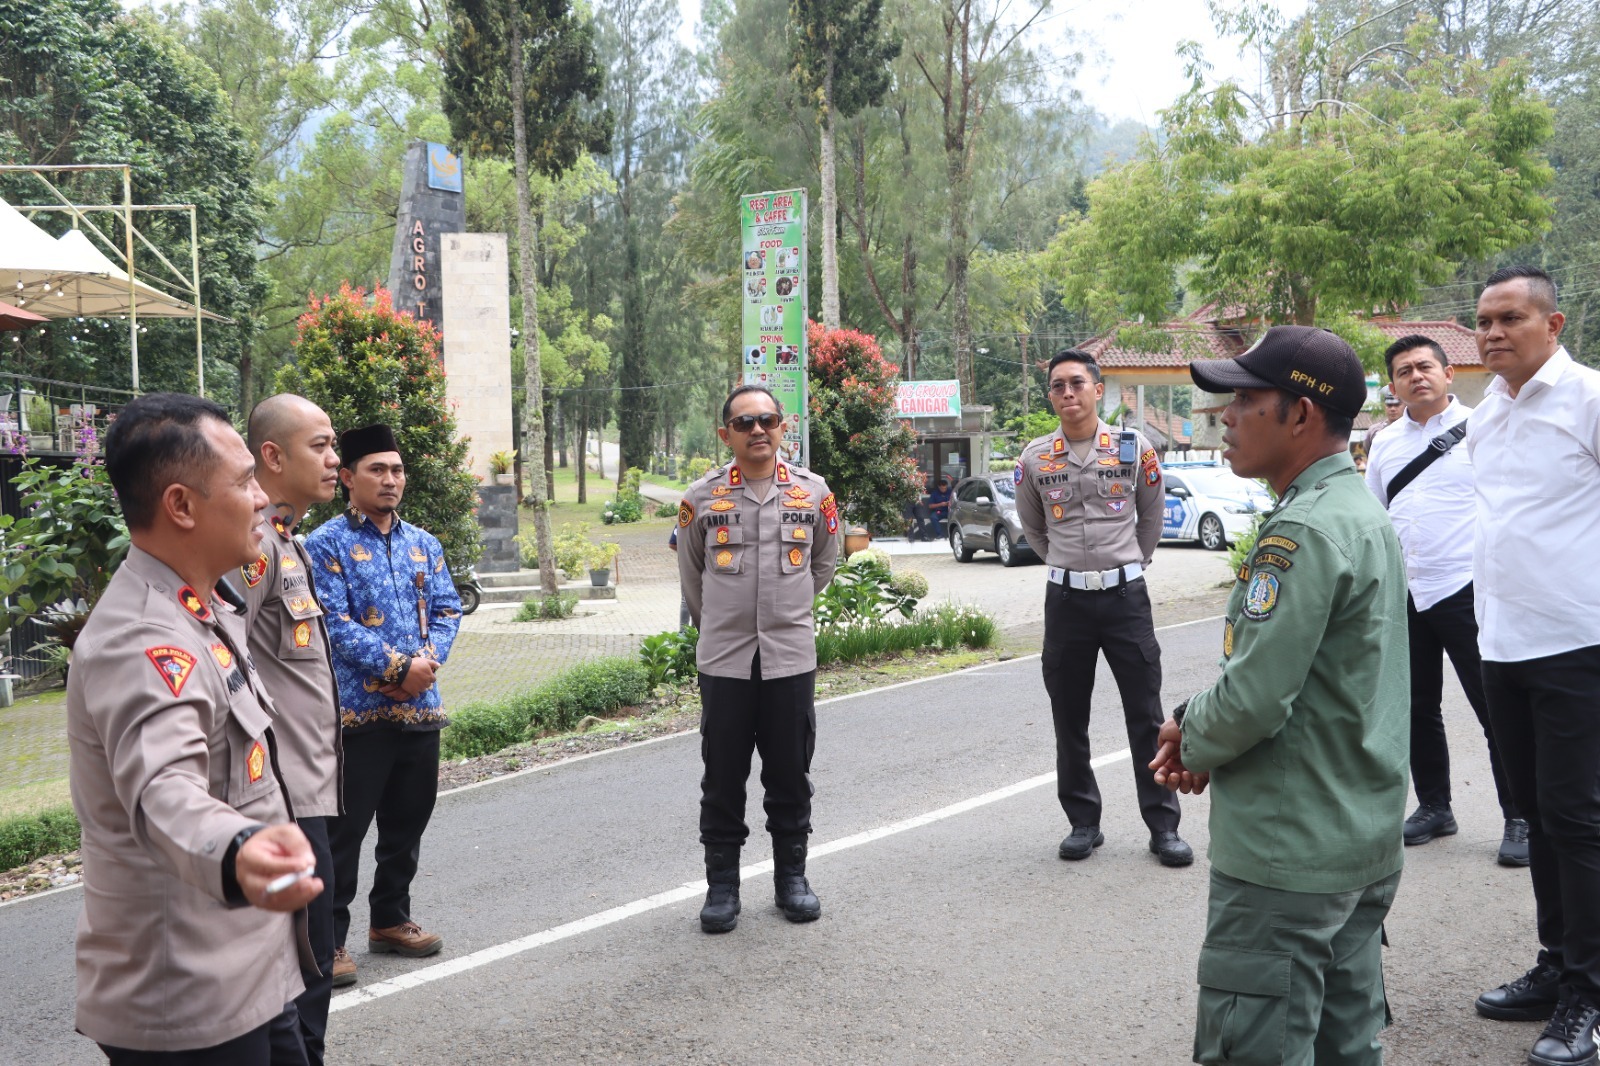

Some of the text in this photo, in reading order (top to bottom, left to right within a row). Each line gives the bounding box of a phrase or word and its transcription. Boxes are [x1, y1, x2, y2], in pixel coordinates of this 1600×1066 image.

[750, 196, 793, 211] REST AREA
[755, 210, 787, 223] & CAFFE
[760, 240, 782, 248] FOOD
[413, 219, 426, 291] AGRO
[760, 335, 783, 343] DRINK
[916, 383, 957, 397] GROUND
[902, 398, 949, 413] CANGAR
[1038, 473, 1069, 486] KEVIN
[1098, 468, 1131, 479] POLRI
[707, 514, 729, 528] ANDI
[783, 512, 815, 524] POLRI
